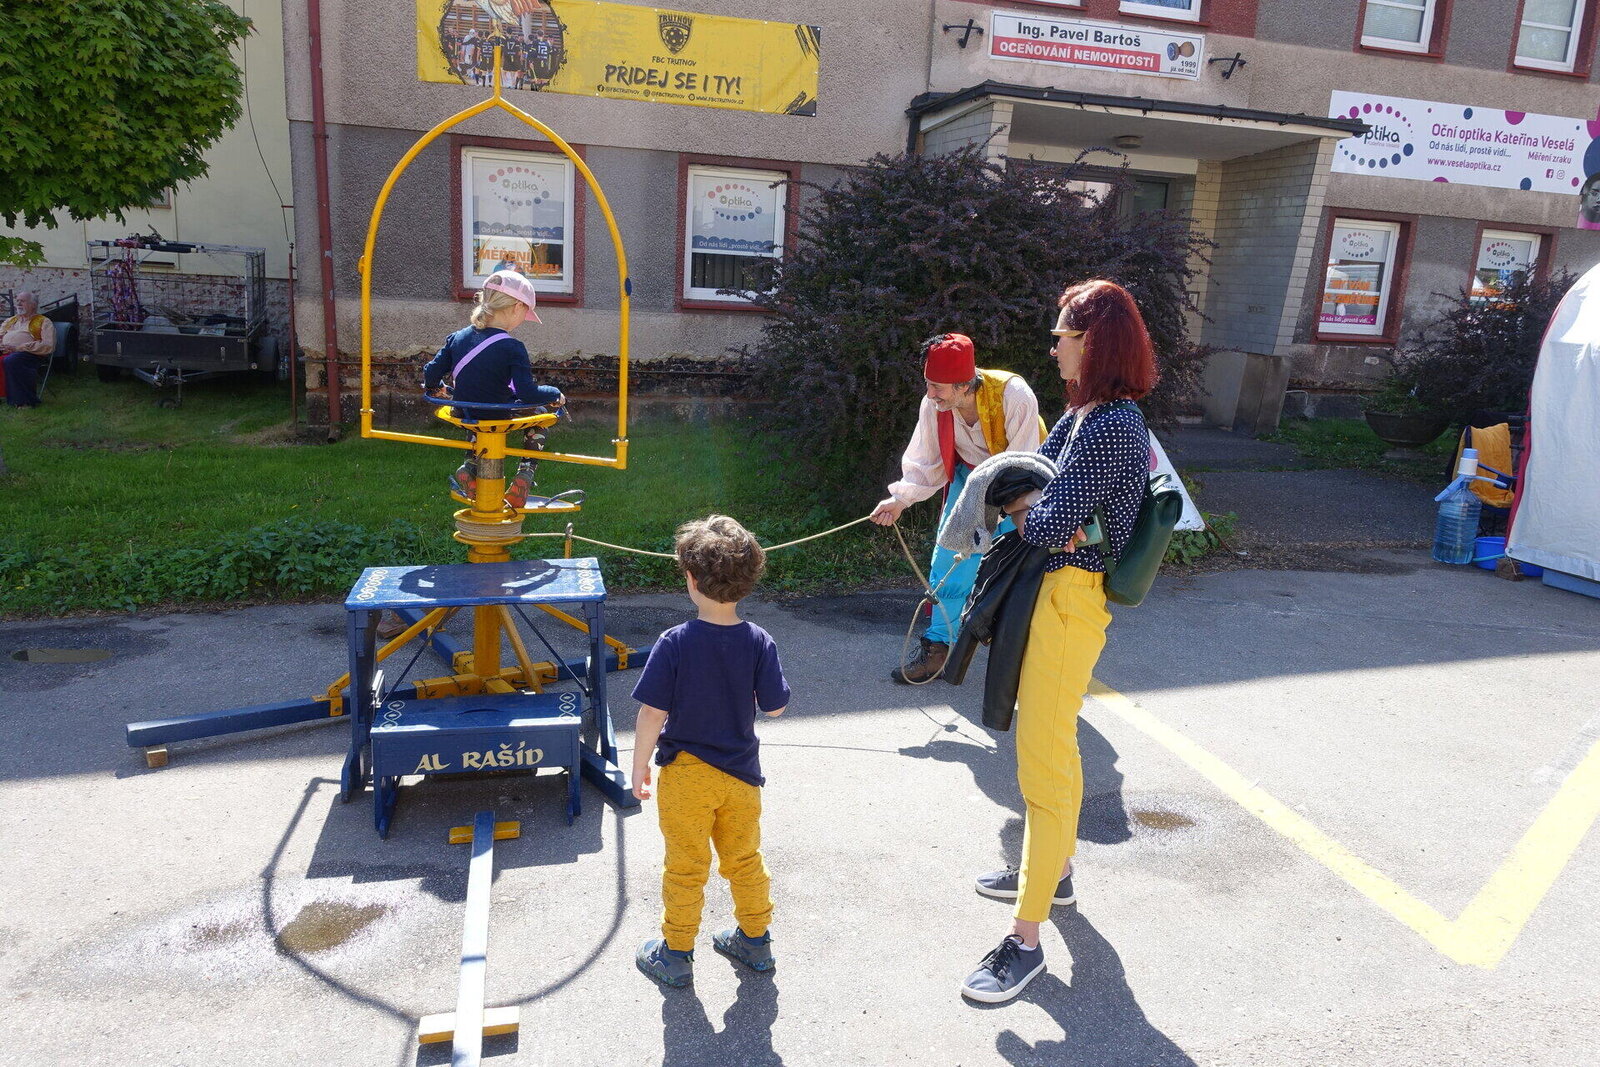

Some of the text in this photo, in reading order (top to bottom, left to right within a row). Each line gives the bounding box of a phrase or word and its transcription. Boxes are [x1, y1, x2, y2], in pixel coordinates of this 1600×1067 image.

[1017, 22, 1141, 47] Ing. Pavel Bartoš
[667, 57, 697, 67] TRUTNOV
[1000, 41, 1155, 68] OCEŇOVÁNÍ NEMOVITOSTÍ
[605, 60, 743, 95] PŘIDEJ SE I TY!
[1429, 141, 1440, 150] Od
[1441, 142, 1453, 151] nás
[1469, 147, 1492, 155] prostě
[1432, 123, 1575, 151] Oční optika Kateřina Veselá
[1427, 158, 1501, 171] www.veselaoptika.cz
[1528, 151, 1572, 164] Měření zraku
[413, 741, 544, 774] AL RAŠÍD
